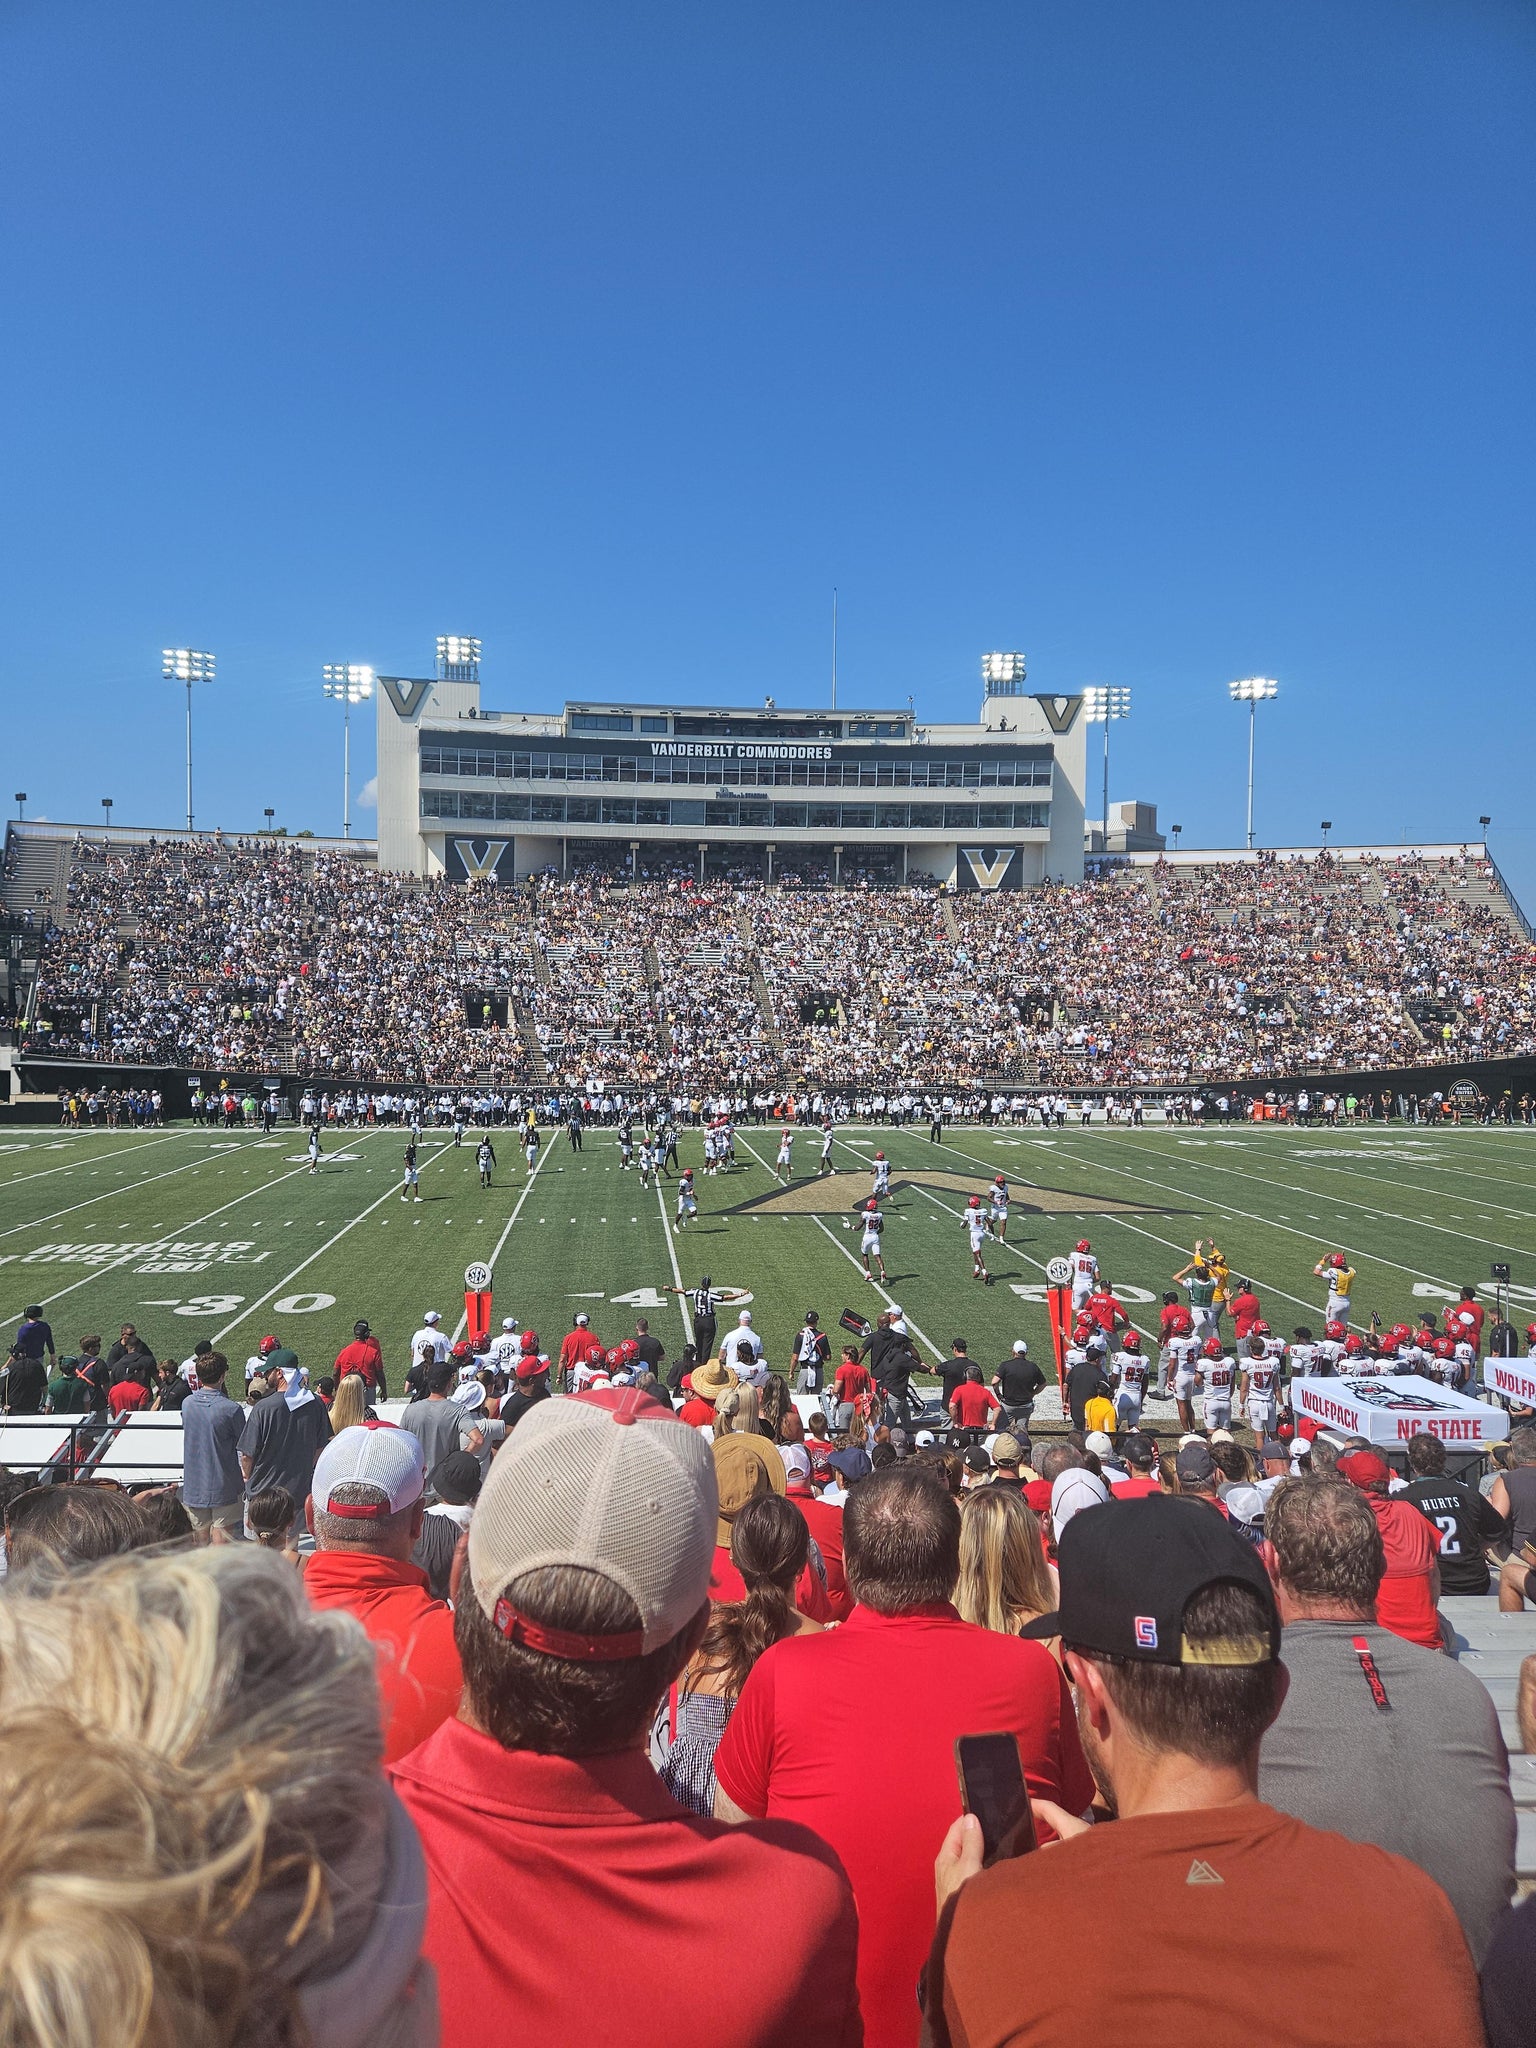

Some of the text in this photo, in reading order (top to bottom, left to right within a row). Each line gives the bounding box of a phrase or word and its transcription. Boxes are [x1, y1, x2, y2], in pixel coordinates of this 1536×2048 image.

[651, 743, 832, 760] VANDERBILT COMMODORES
[1253, 1371, 1273, 1389] 97
[1301, 1389, 1359, 1433] WOLFPACK
[1398, 1419, 1482, 1440] NC STATE
[1421, 1496, 1460, 1511] HURTS
[1436, 1516, 1460, 1555] 2
